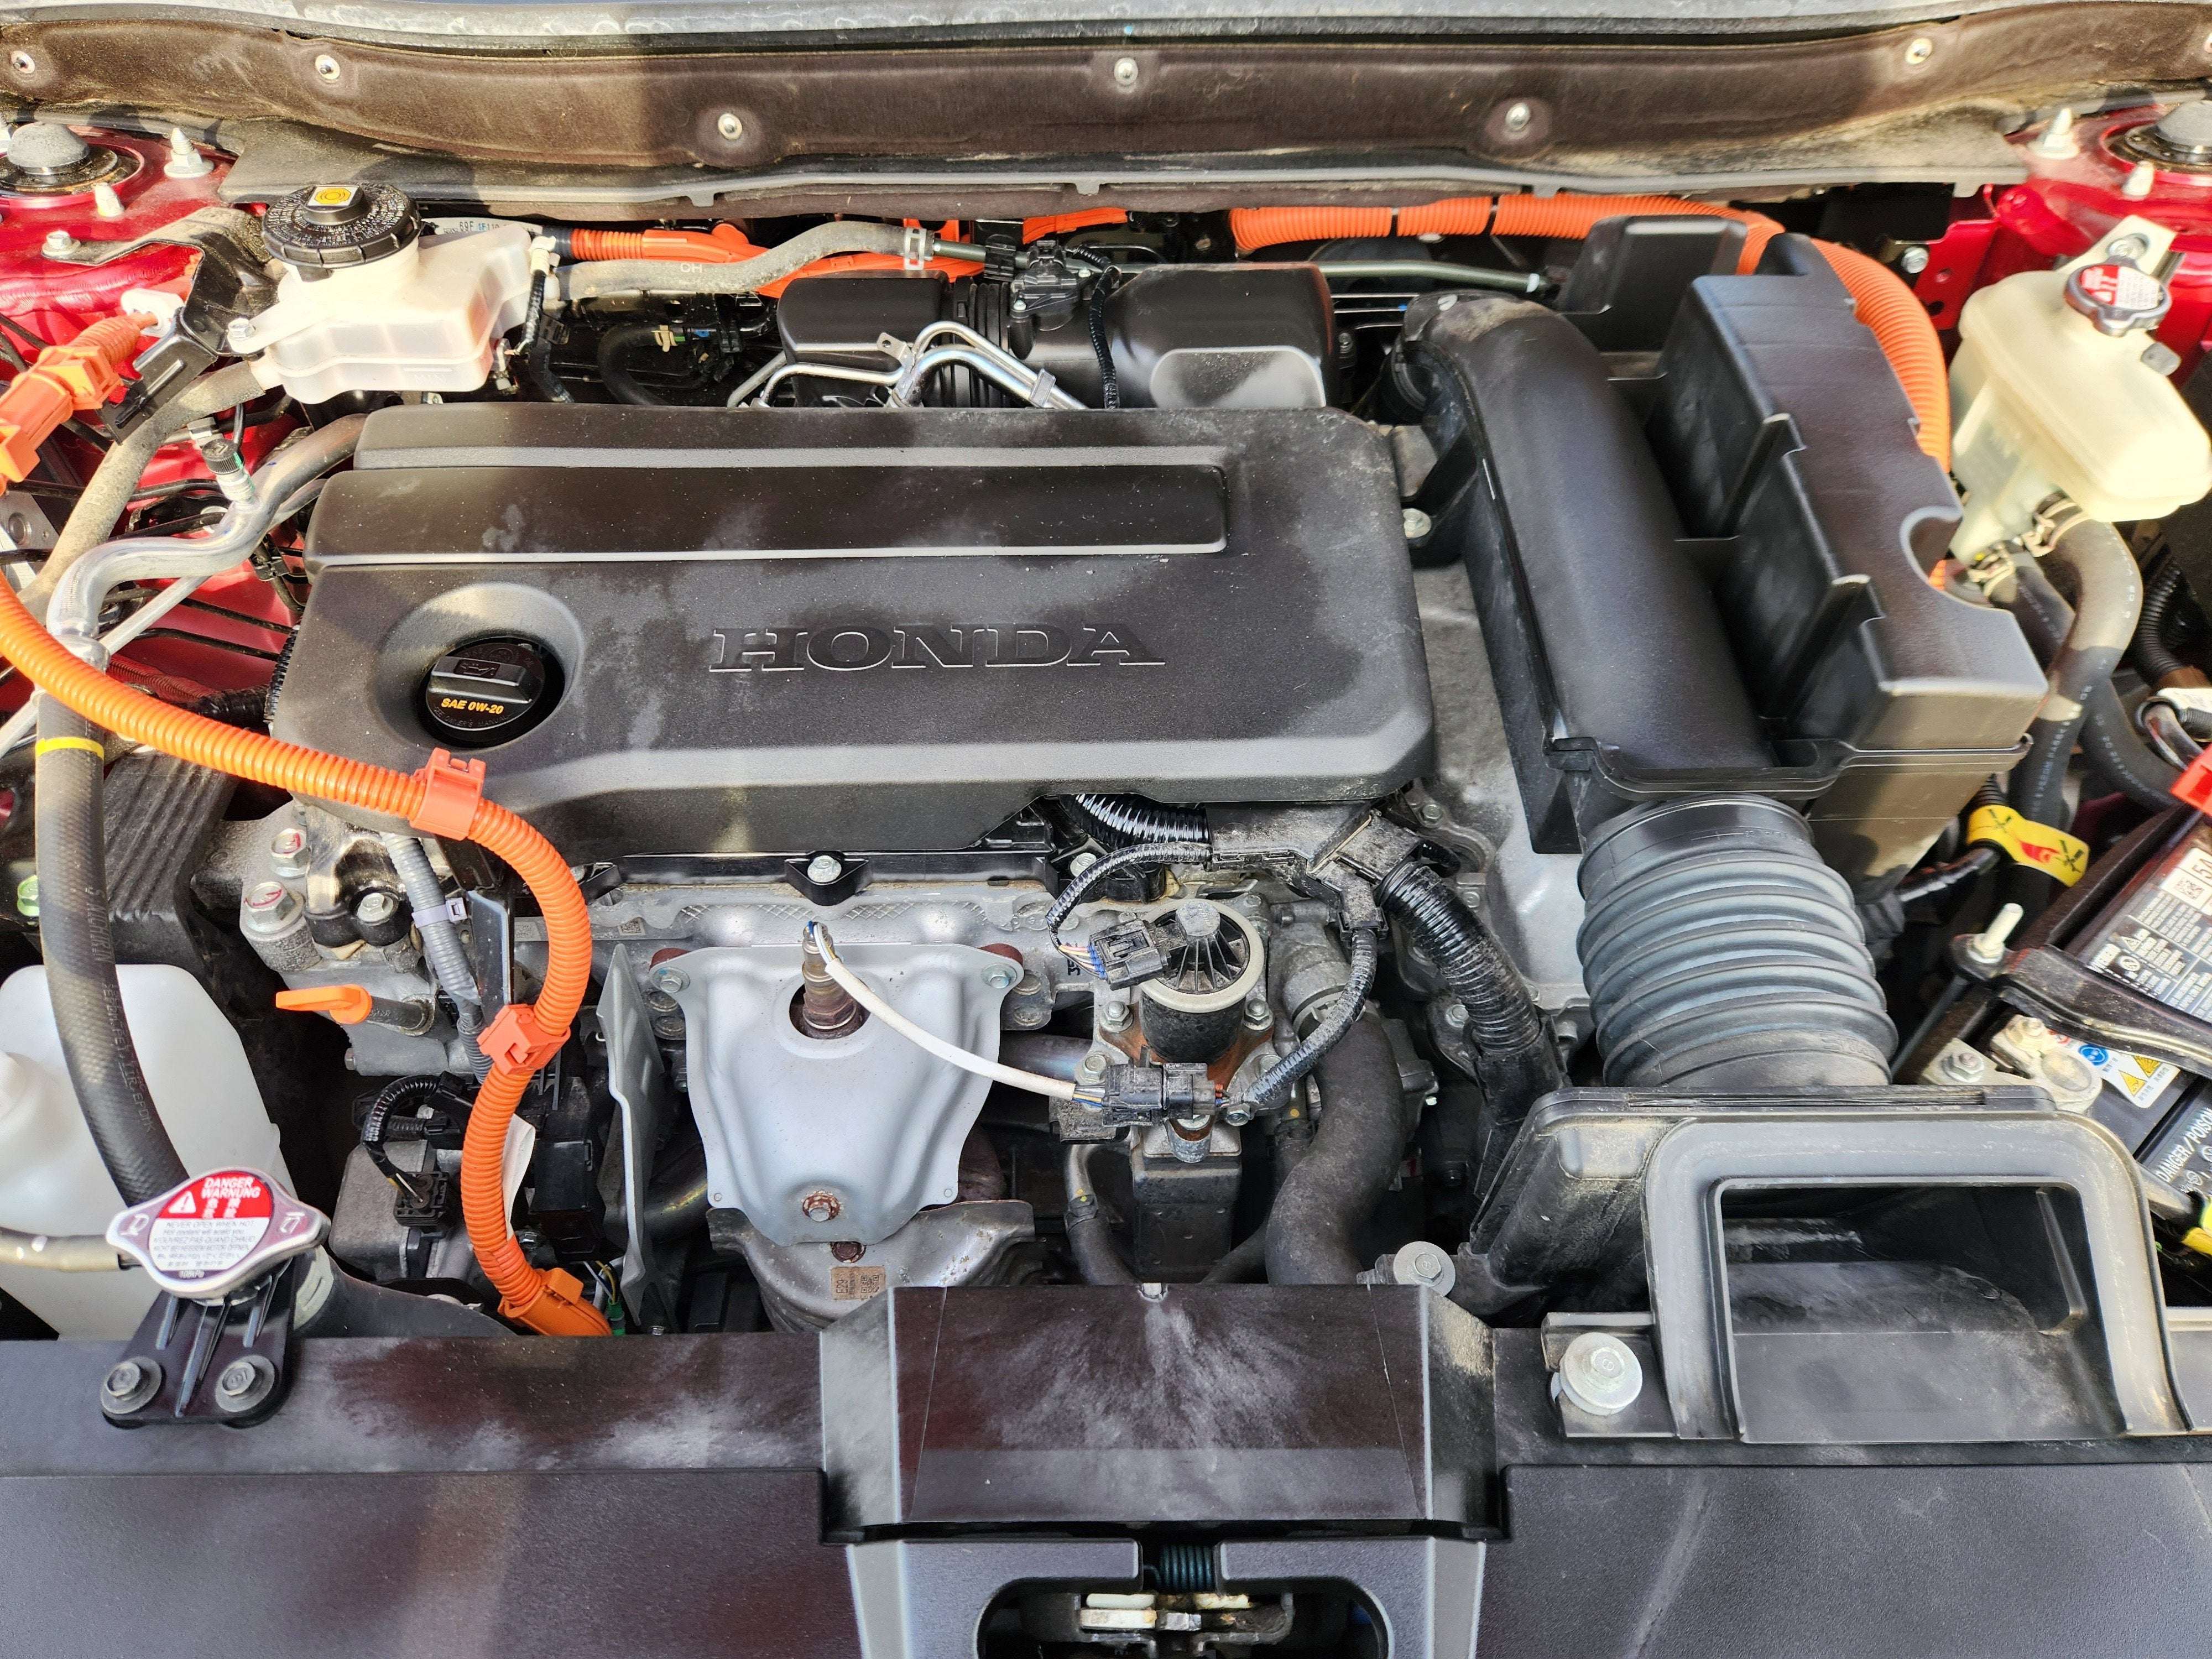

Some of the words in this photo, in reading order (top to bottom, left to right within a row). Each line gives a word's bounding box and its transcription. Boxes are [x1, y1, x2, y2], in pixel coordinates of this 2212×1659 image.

[708, 623, 1166, 672] HONDA
[441, 698, 467, 709] SAE
[468, 701, 504, 714] 0W-20
[204, 1177, 254, 1188] DANGER
[201, 1186, 261, 1199] WARNUNG
